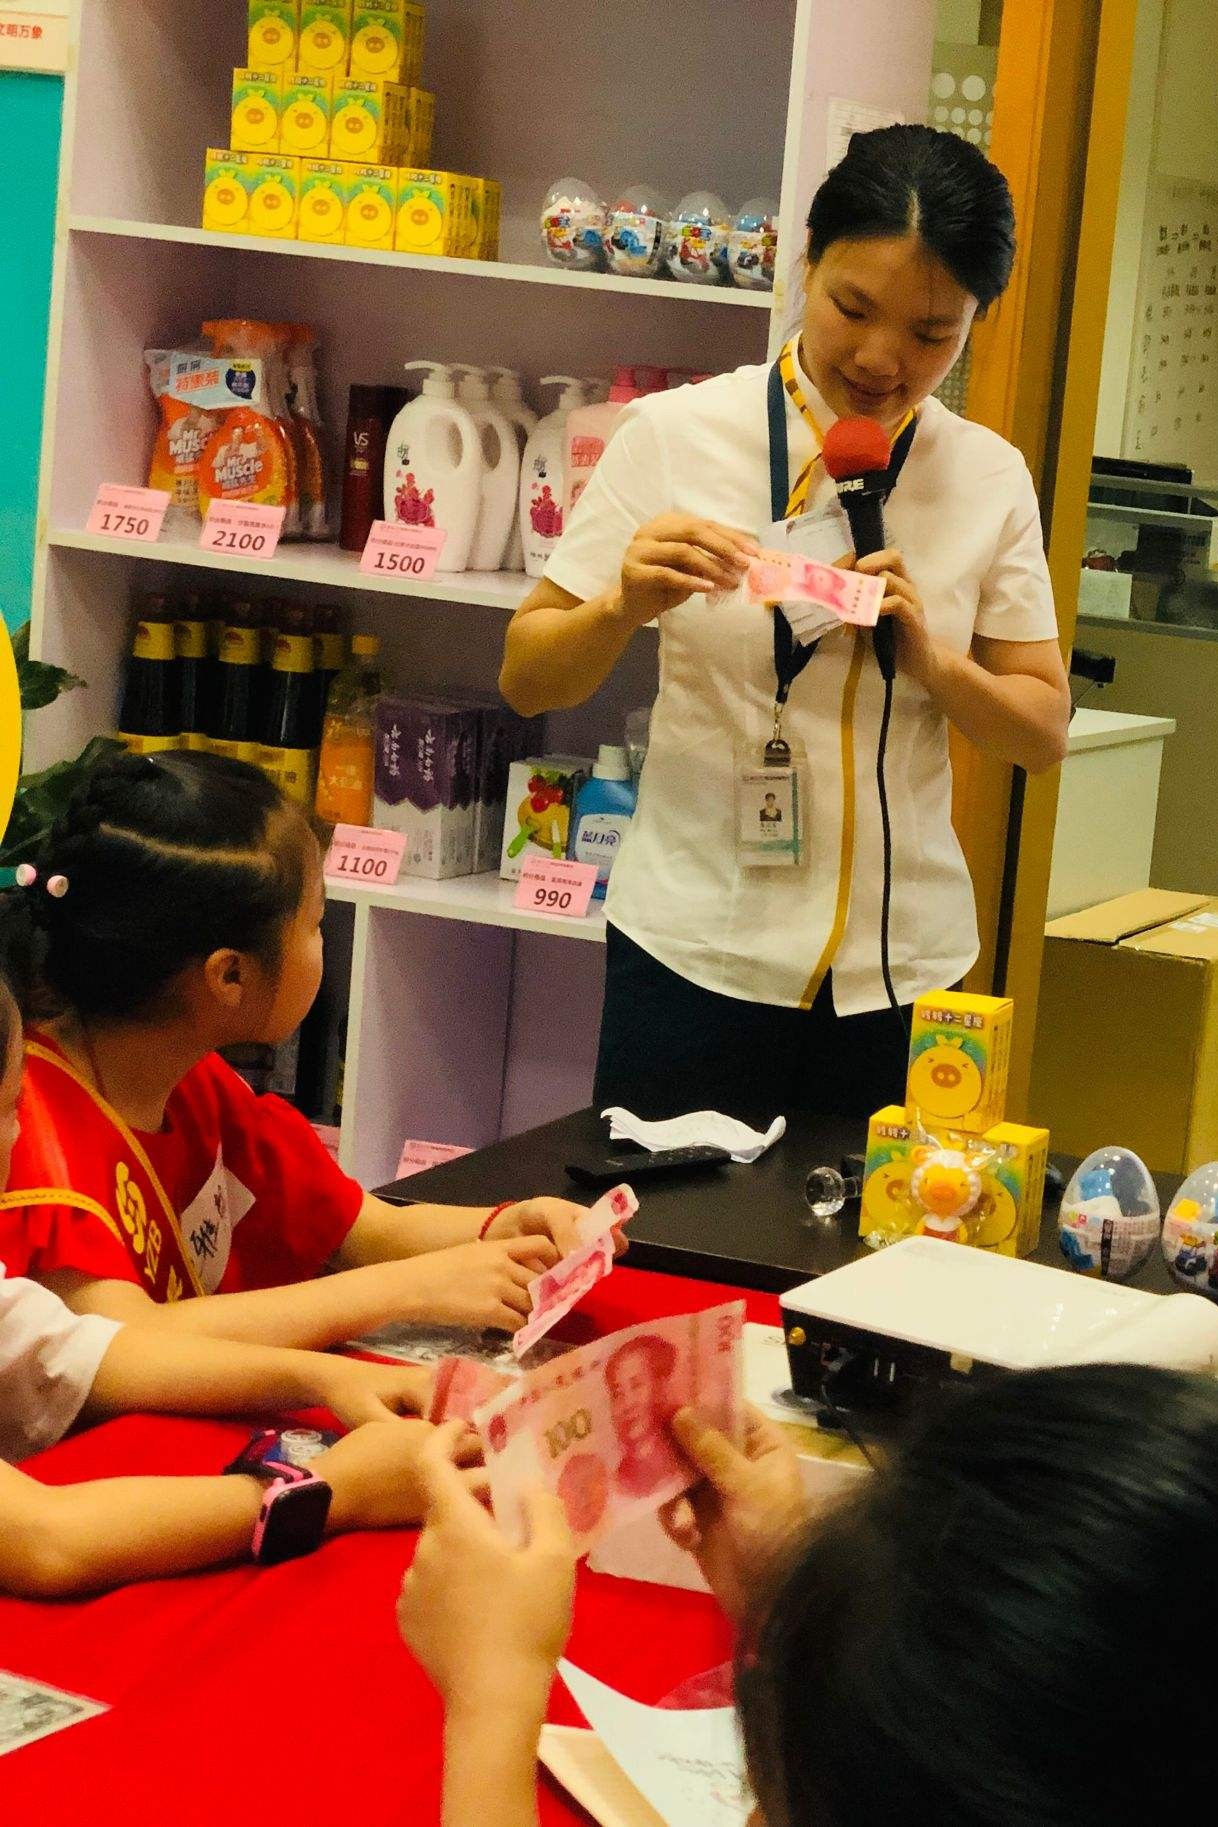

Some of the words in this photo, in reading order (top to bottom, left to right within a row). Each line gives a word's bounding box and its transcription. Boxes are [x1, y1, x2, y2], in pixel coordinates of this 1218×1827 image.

[100, 513, 150, 536] 1750
[212, 530, 266, 551] 2100
[373, 551, 426, 574] 1500
[337, 854, 388, 878] 1100
[533, 888, 572, 909] 990
